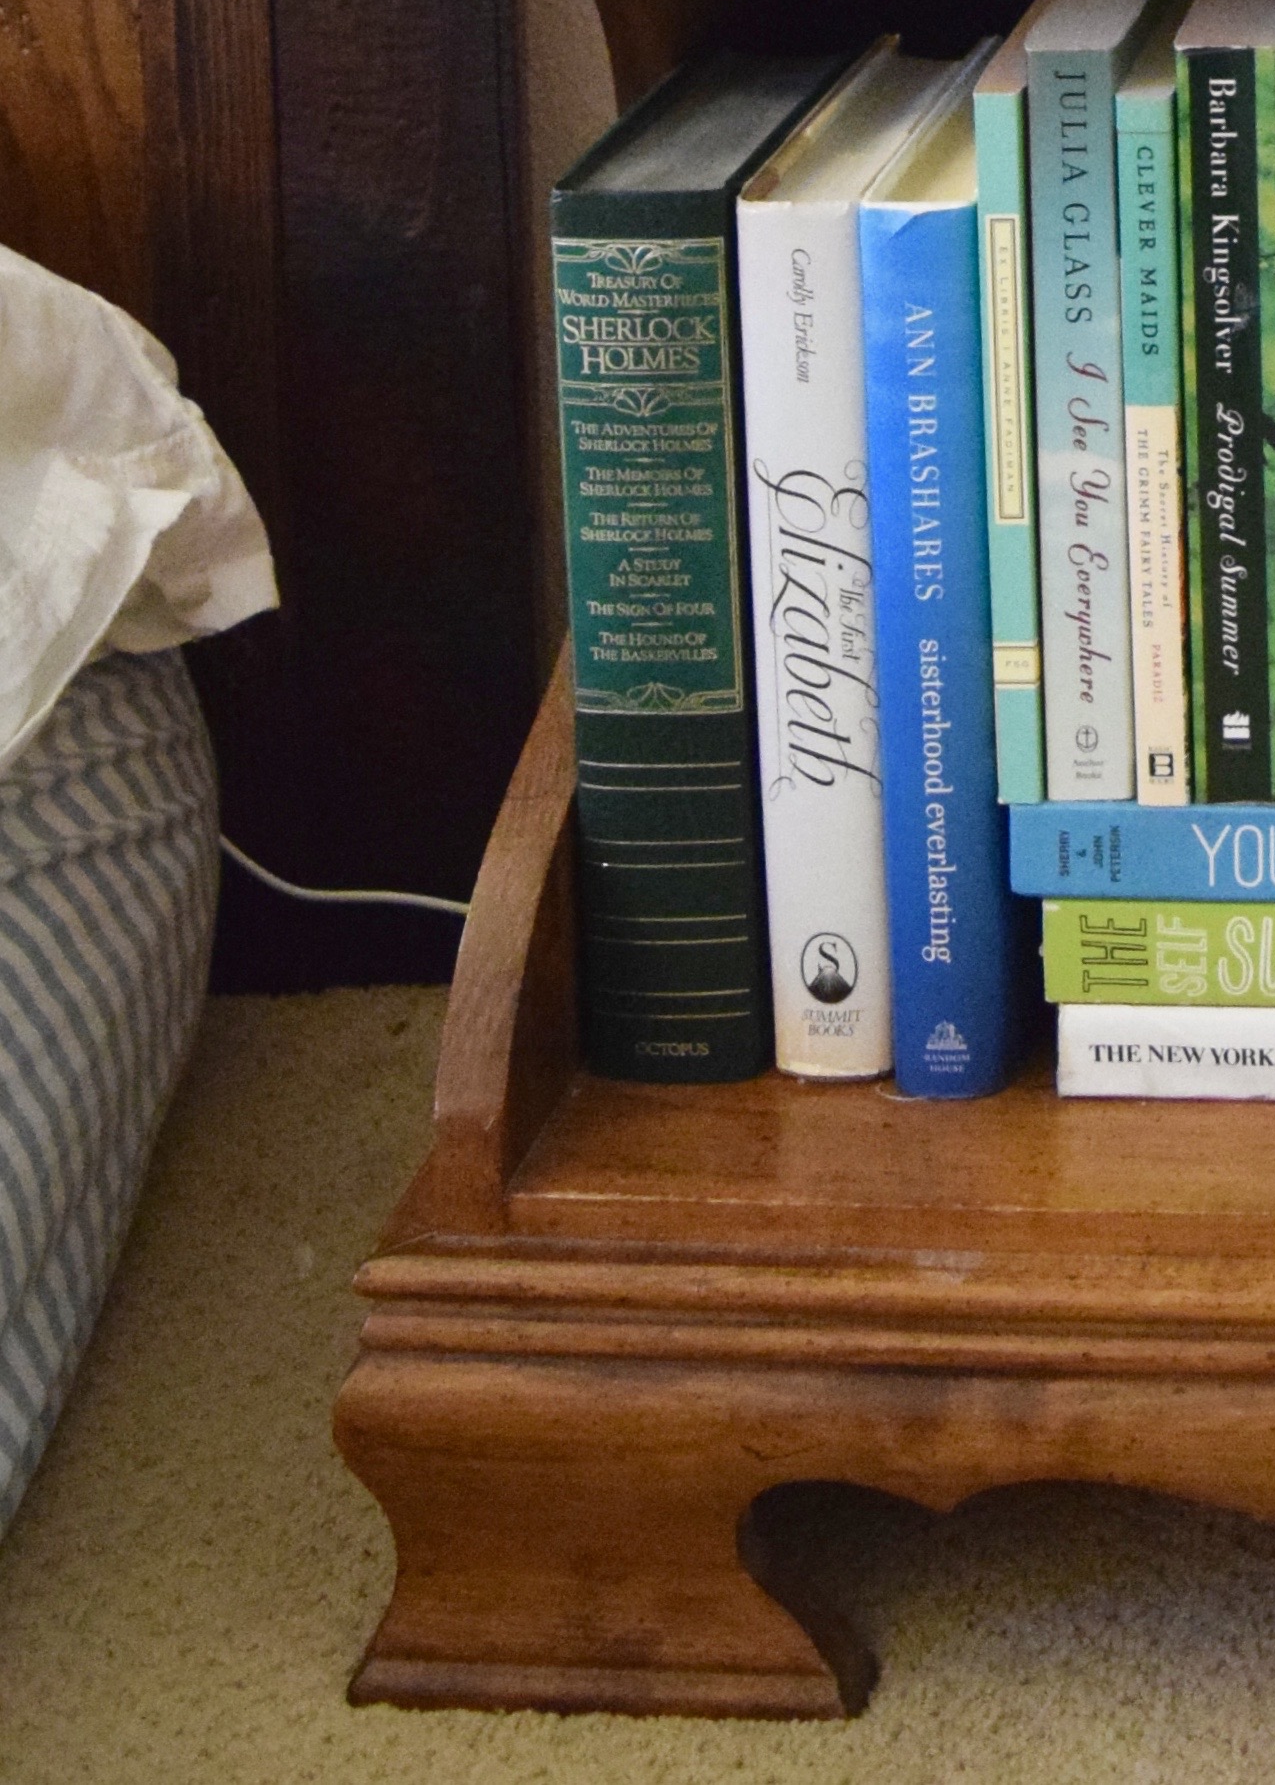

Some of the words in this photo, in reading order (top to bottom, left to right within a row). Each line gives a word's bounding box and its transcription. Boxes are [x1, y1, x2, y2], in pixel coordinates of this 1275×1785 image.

[1054, 71, 1088, 183] JULIA
[1207, 77, 1237, 199] Barbara
[1136, 145, 1156, 251] CLEVER
[660, 273, 684, 290] OF
[1063, 202, 1093, 324] GLASS
[556, 289, 609, 307] WORLD
[1140, 268, 1159, 356] MAIDS
[1203, 214, 1241, 374] Kingsolver
[562, 315, 716, 344] SHERLOCK
[793, 311, 817, 383] Erickson
[904, 302, 937, 378] ANN
[580, 345, 701, 374] HOLMES
[571, 420, 599, 435] THE
[602, 421, 696, 436] ADVENTURES
[578, 437, 650, 452] SHERLOCK
[653, 438, 713, 452] HOLMES
[1067, 396, 1109, 452] See
[1137, 429, 1149, 460] THE
[586, 465, 615, 480] THE
[616, 465, 680, 480] MEMOIRS
[1160, 449, 1169, 475] The
[1206, 402, 1247, 546] Prodigal
[579, 481, 651, 496] SHERLOCK
[653, 483, 714, 496] HOLMES
[907, 394, 944, 602] BRASHARES
[1070, 468, 1112, 528] You
[1138, 467, 1150, 529] GRIMM
[580, 528, 651, 541] SHERLOCK
[654, 528, 714, 541] HOLMES
[590, 511, 619, 526] THE
[621, 512, 678, 526] RETURN
[618, 558, 631, 571] A
[634, 558, 682, 572] STUDY
[1140, 532, 1152, 579] FAIRY
[1161, 534, 1173, 593] History
[609, 573, 626, 587] IN
[628, 573, 692, 587] SCARLET
[586, 600, 615, 615] THE
[616, 602, 649, 616] SIGN
[676, 602, 715, 616] FOUR
[1065, 542, 1112, 704] Everywhere
[1142, 581, 1154, 630] TALES
[1220, 552, 1248, 676] Summer
[598, 631, 627, 646] THE
[628, 633, 684, 646] HOUND
[753, 458, 883, 802] Elizabeth
[590, 647, 618, 661] THE
[621, 648, 718, 661] BASKERVILLES
[919, 638, 954, 797] sisterhood
[1058, 830, 1070, 878] SHERRY
[1093, 835, 1103, 869] JOHN
[1109, 825, 1121, 884] PETERSIK
[921, 802, 957, 963] everlasting
[1079, 914, 1149, 994] THE
[1155, 911, 1209, 997] SELF
[801, 1008, 863, 1023] SUMMIT
[807, 1024, 854, 1037] BOOKS
[635, 1041, 709, 1057] OCTOPUS
[923, 1053, 971, 1062] RANDOM
[929, 1064, 965, 1073] HOUSE
[1088, 1043, 1142, 1064] THE
[1147, 1044, 1203, 1065] NEW
[1204, 1046, 1275, 1067] YORK
